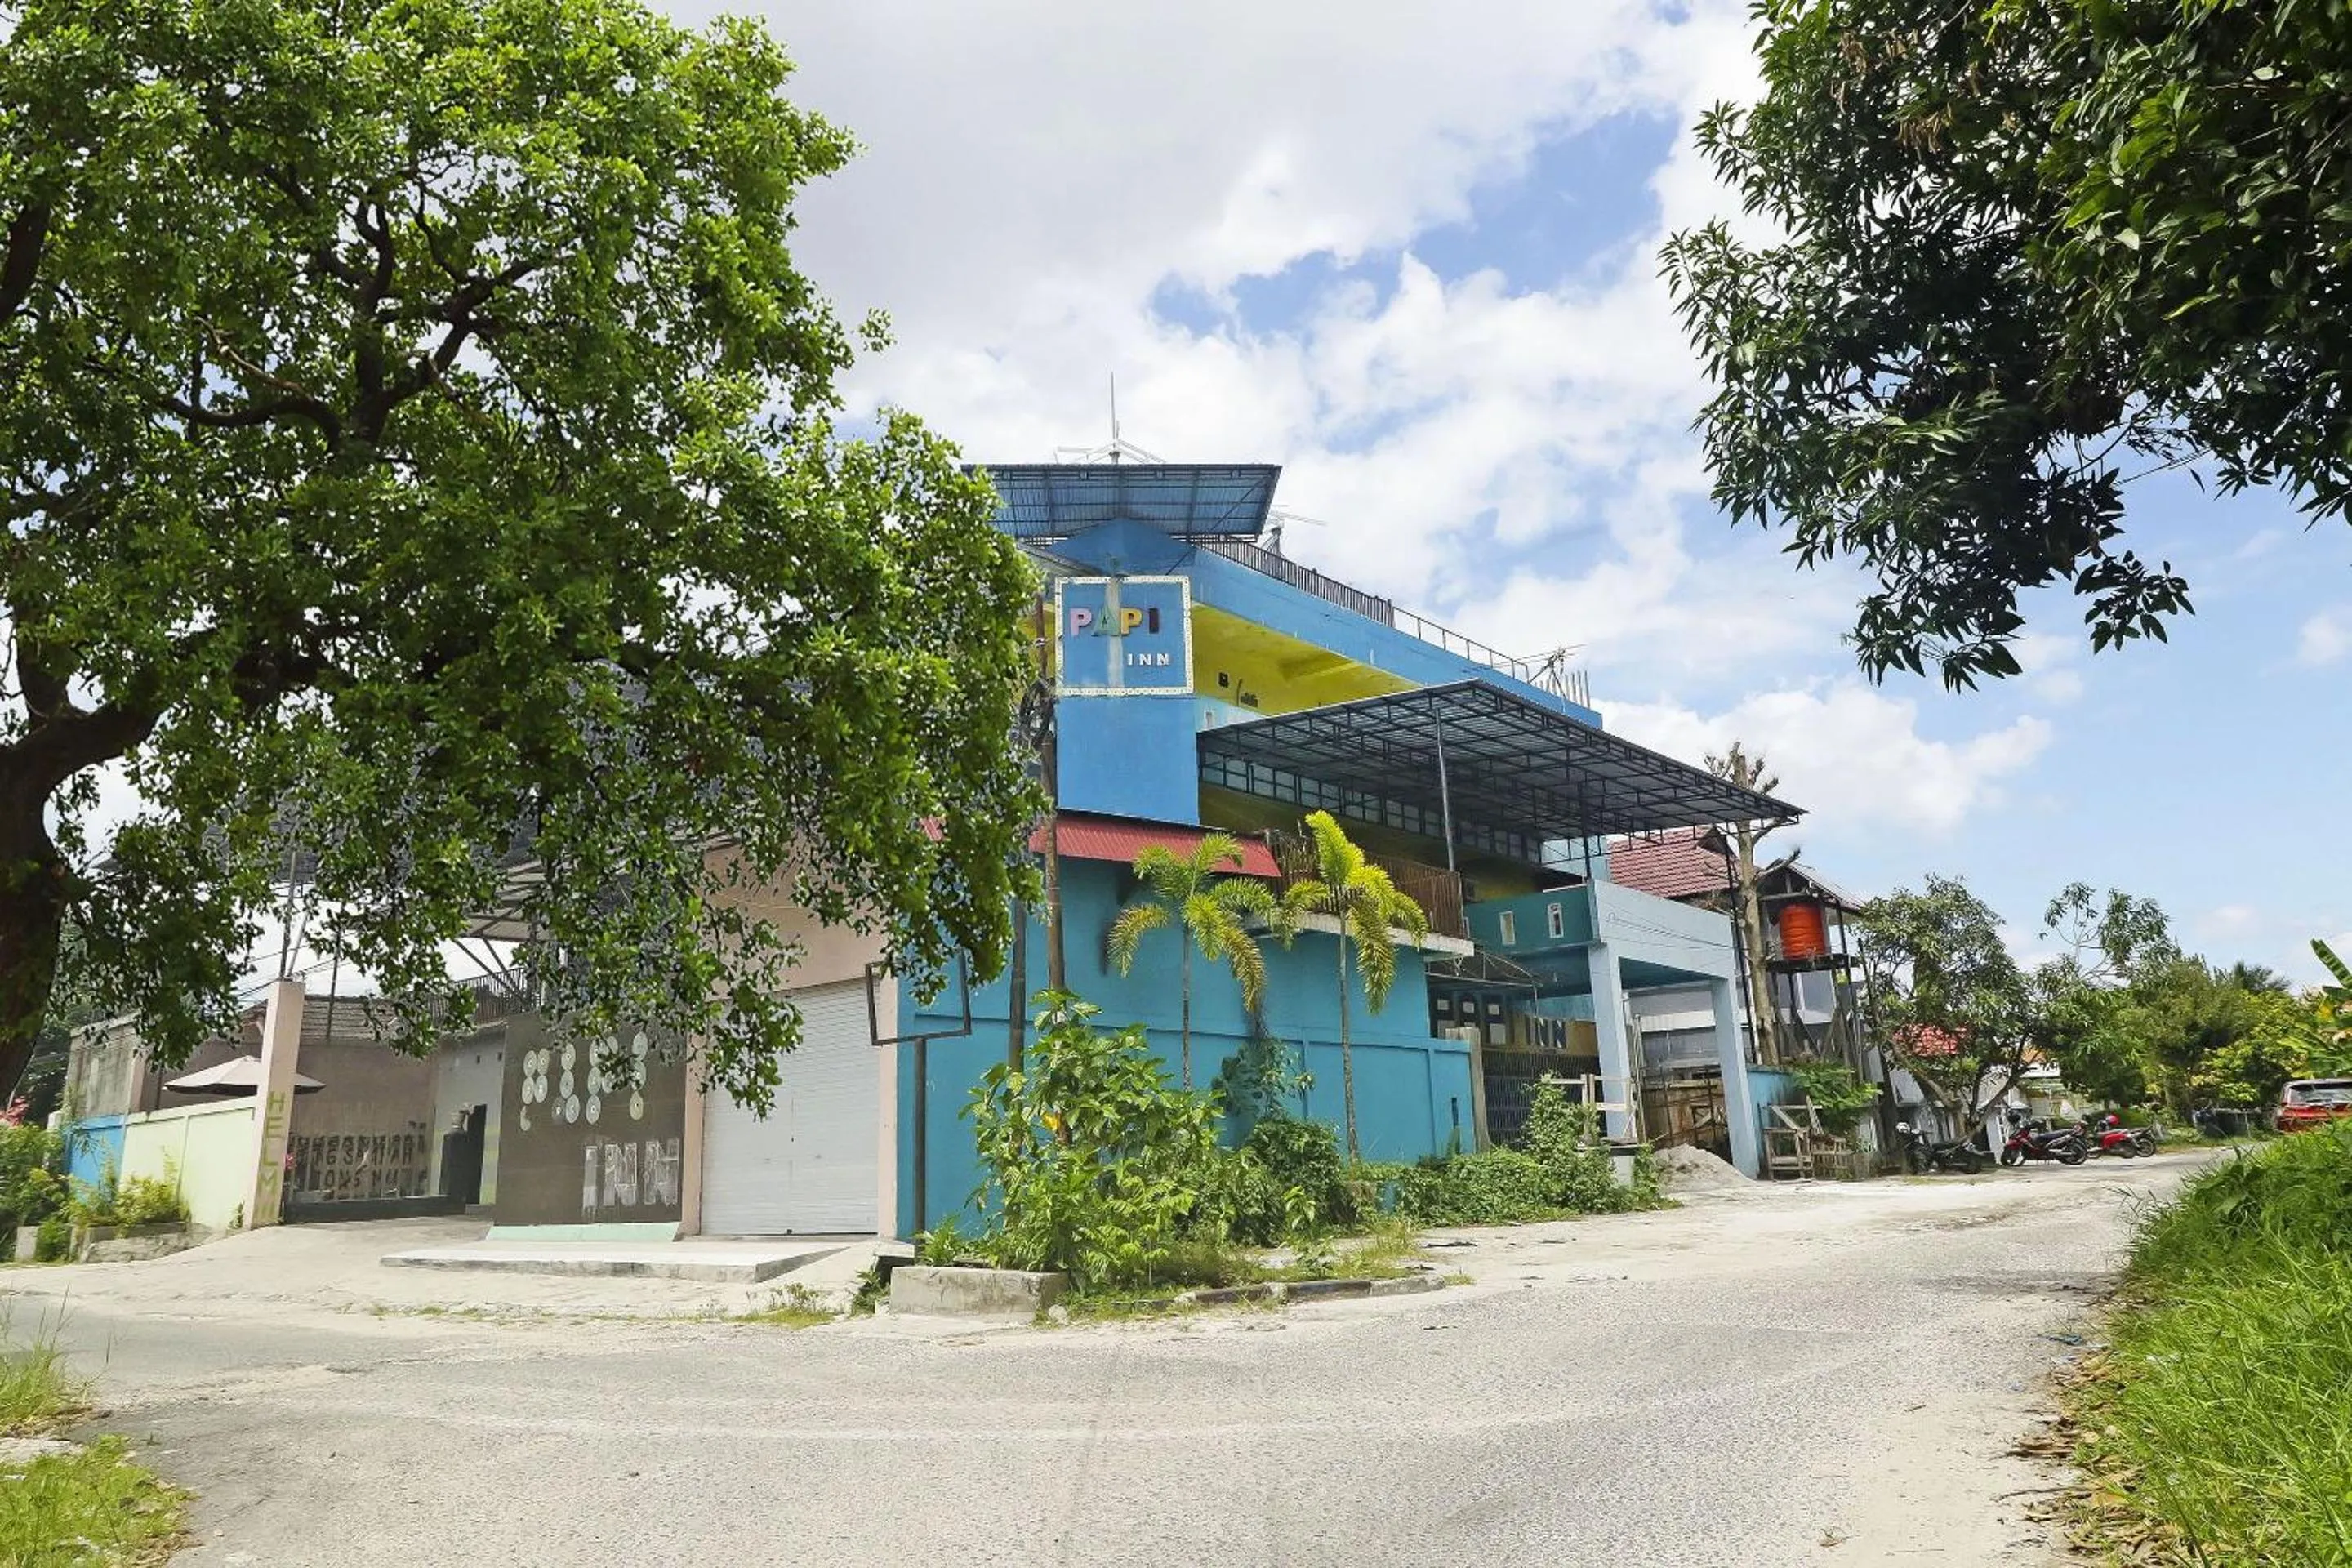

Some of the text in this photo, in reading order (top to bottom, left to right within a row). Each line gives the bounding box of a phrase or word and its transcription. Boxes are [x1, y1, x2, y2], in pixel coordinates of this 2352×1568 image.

[1069, 606, 1160, 636] PAPI
[1127, 653, 1171, 666] INN
[582, 1138, 679, 1210] INN
